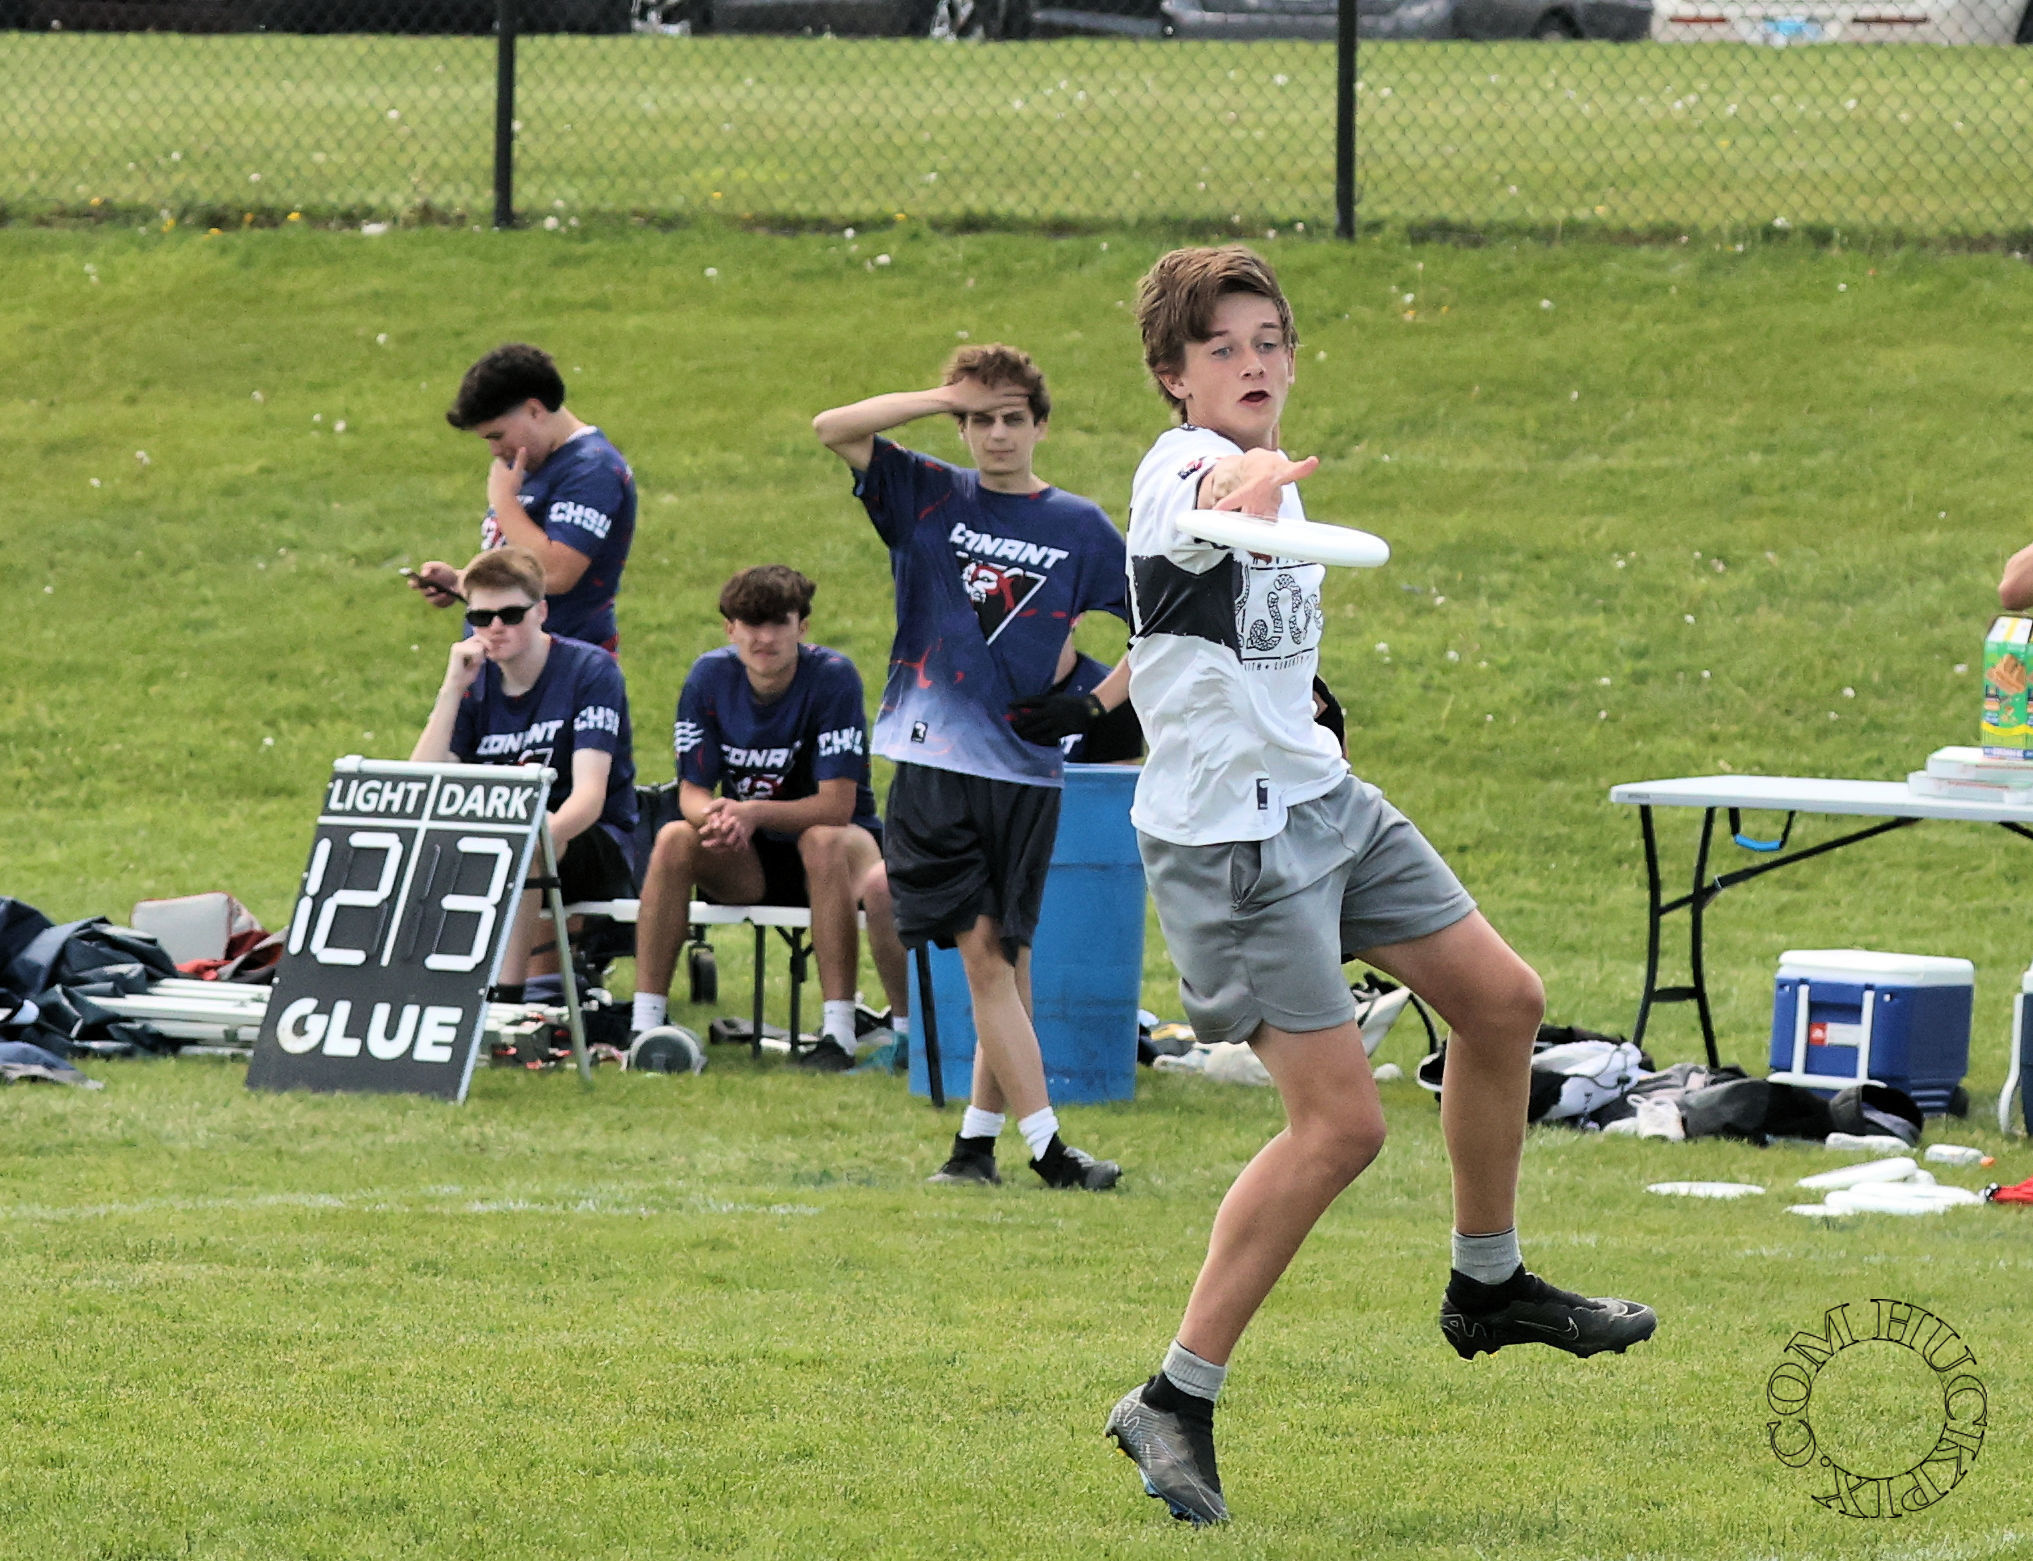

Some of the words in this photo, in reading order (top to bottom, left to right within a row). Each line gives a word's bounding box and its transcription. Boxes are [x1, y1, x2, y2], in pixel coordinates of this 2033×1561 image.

[327, 778, 426, 814] LIGHT
[436, 782, 534, 820] DARK
[287, 831, 404, 966] 12
[424, 836, 514, 972] 3
[275, 997, 463, 1063] GLUE
